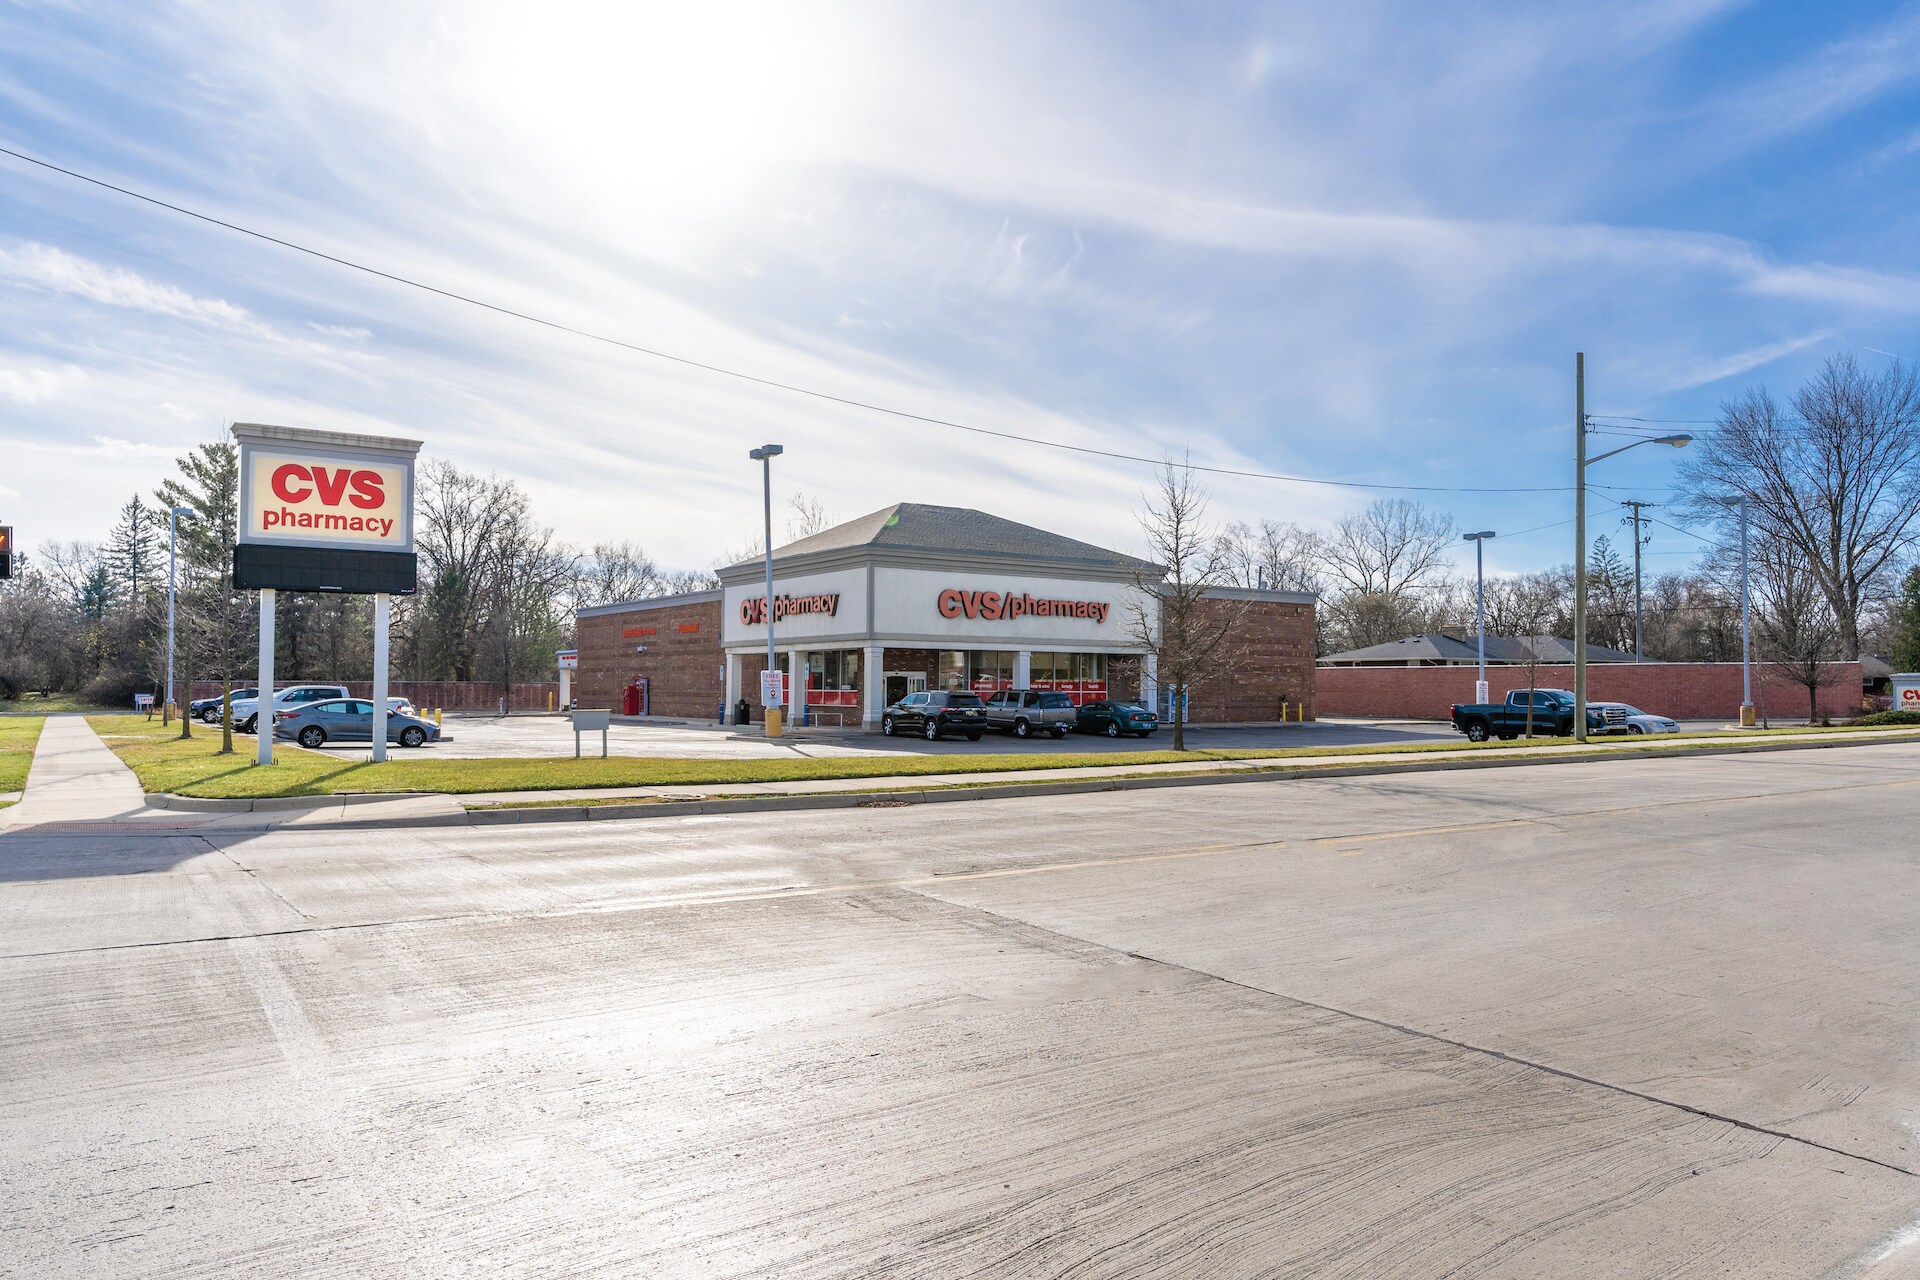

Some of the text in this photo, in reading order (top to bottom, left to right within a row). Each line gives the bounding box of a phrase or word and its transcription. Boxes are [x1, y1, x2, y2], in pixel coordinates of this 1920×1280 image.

[271, 463, 386, 510] CVS
[262, 507, 394, 538] pharmacy
[938, 588, 1111, 624] CVS/pharmacy
